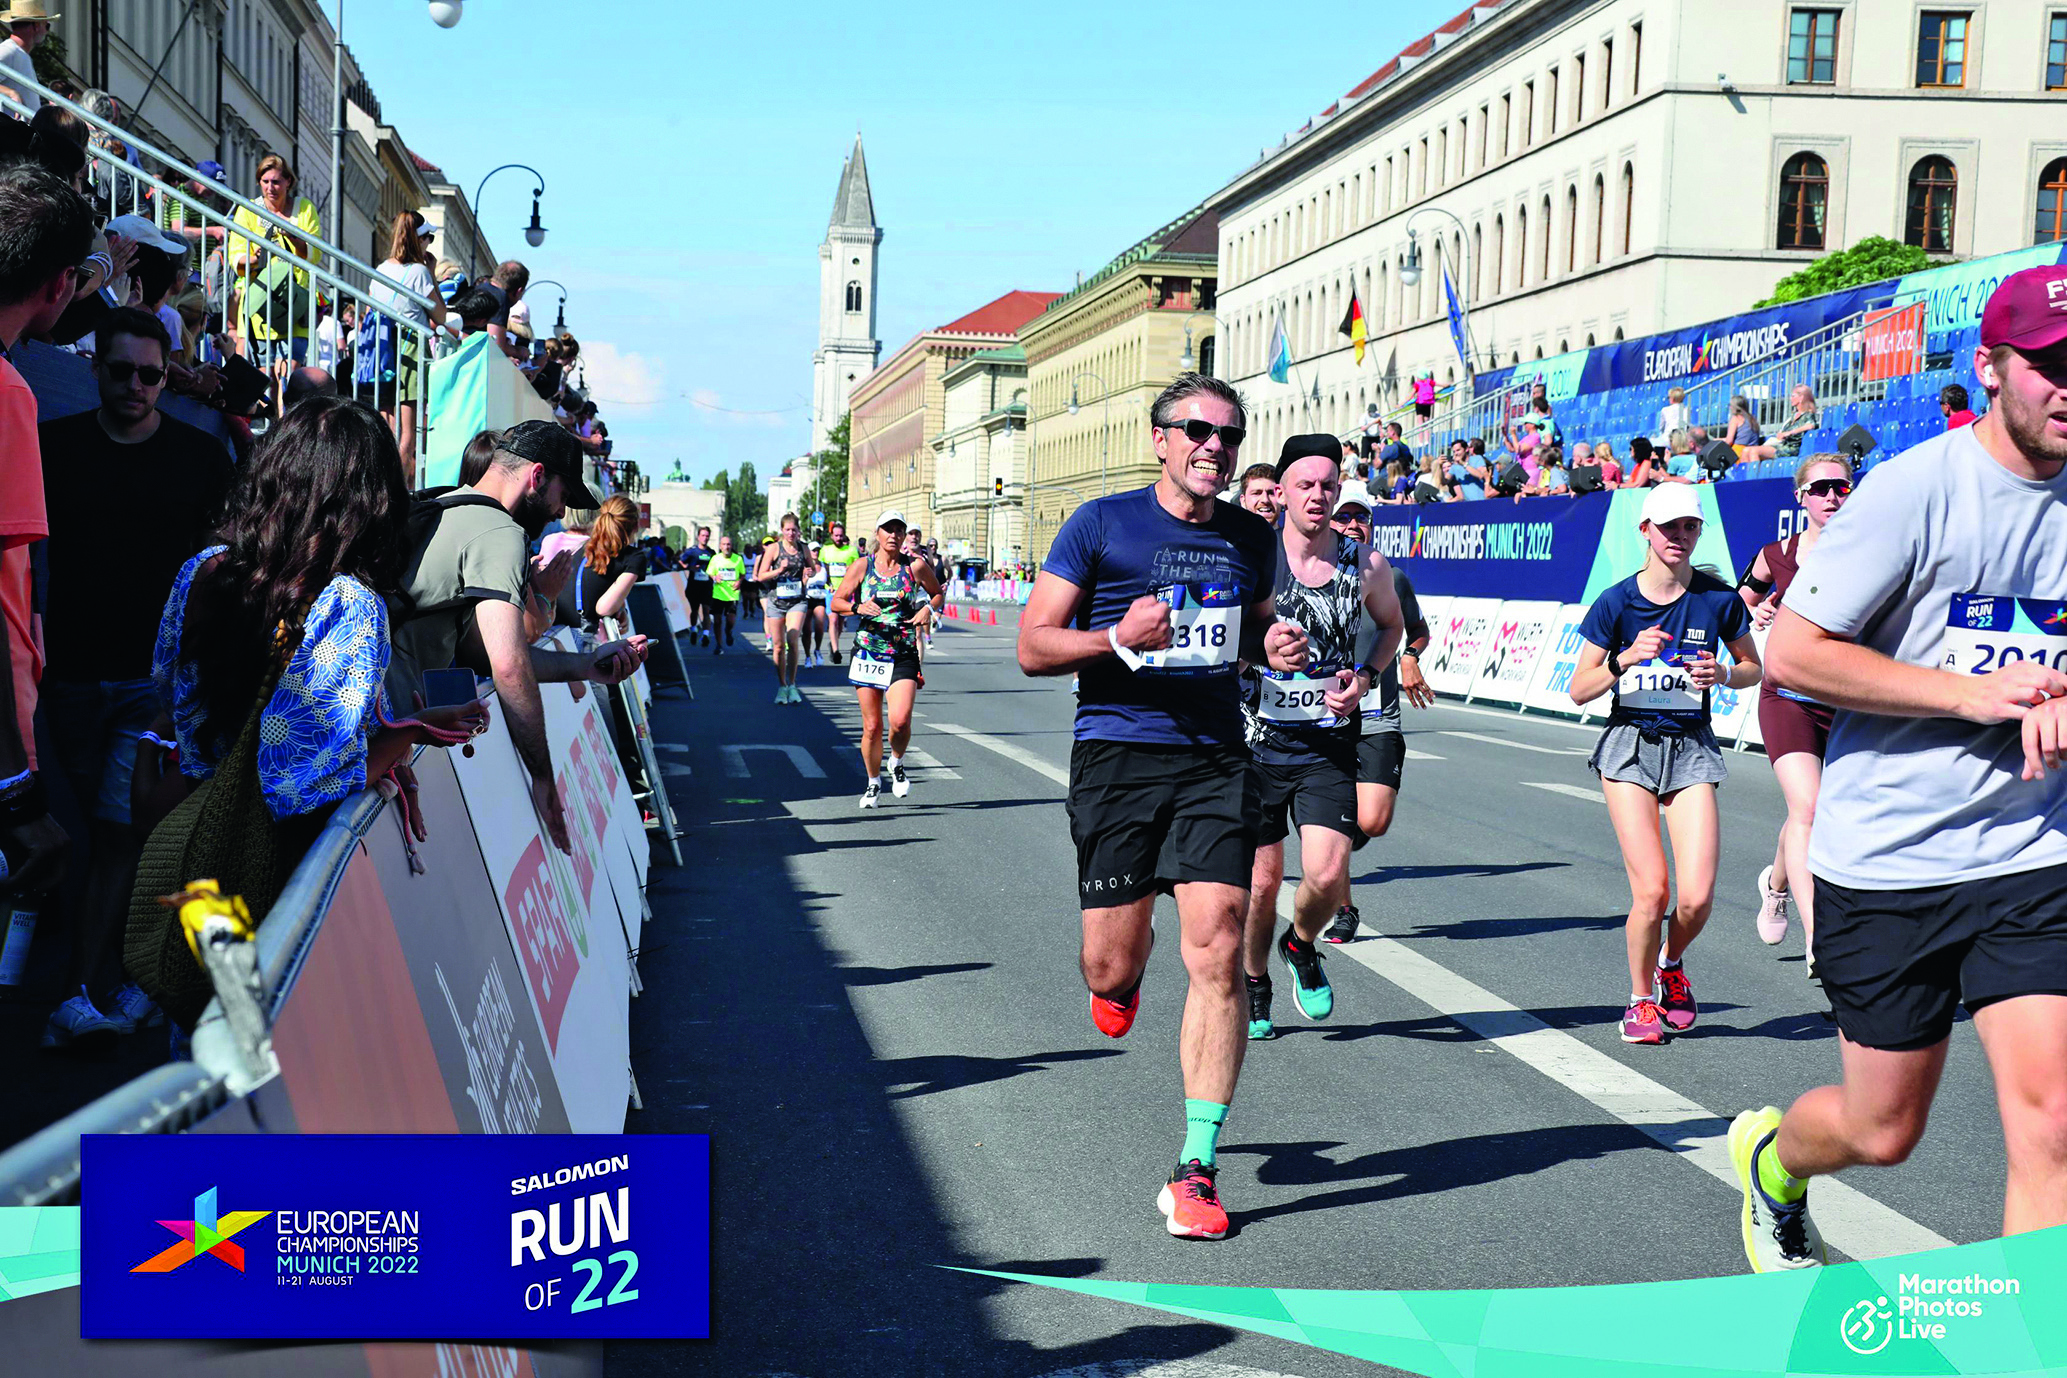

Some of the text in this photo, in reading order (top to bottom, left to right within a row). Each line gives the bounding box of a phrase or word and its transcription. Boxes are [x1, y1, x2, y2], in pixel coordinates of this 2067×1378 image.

[1896, 329, 1918, 352] 202
[1644, 322, 1790, 381] EUROPEAN CHAMPIONSHIPS
[1373, 522, 1553, 560] EUROPEAN CHAMPIONSHIPS MUNICH 2022
[1178, 550, 1215, 565] RUN
[1160, 564, 1192, 578] THE
[1966, 603, 1993, 618] RUN
[1977, 616, 1993, 628] 22
[1555, 623, 1585, 654] TOY
[1687, 628, 1706, 640] TUM
[1945, 653, 1956, 666] A
[857, 663, 885, 675] 1176
[1635, 674, 1688, 692] 1104
[1274, 689, 1326, 708] 2502
[1648, 696, 1671, 704] Laura
[518, 861, 571, 1003] SPAR
[472, 956, 515, 1100] EUROPEAN
